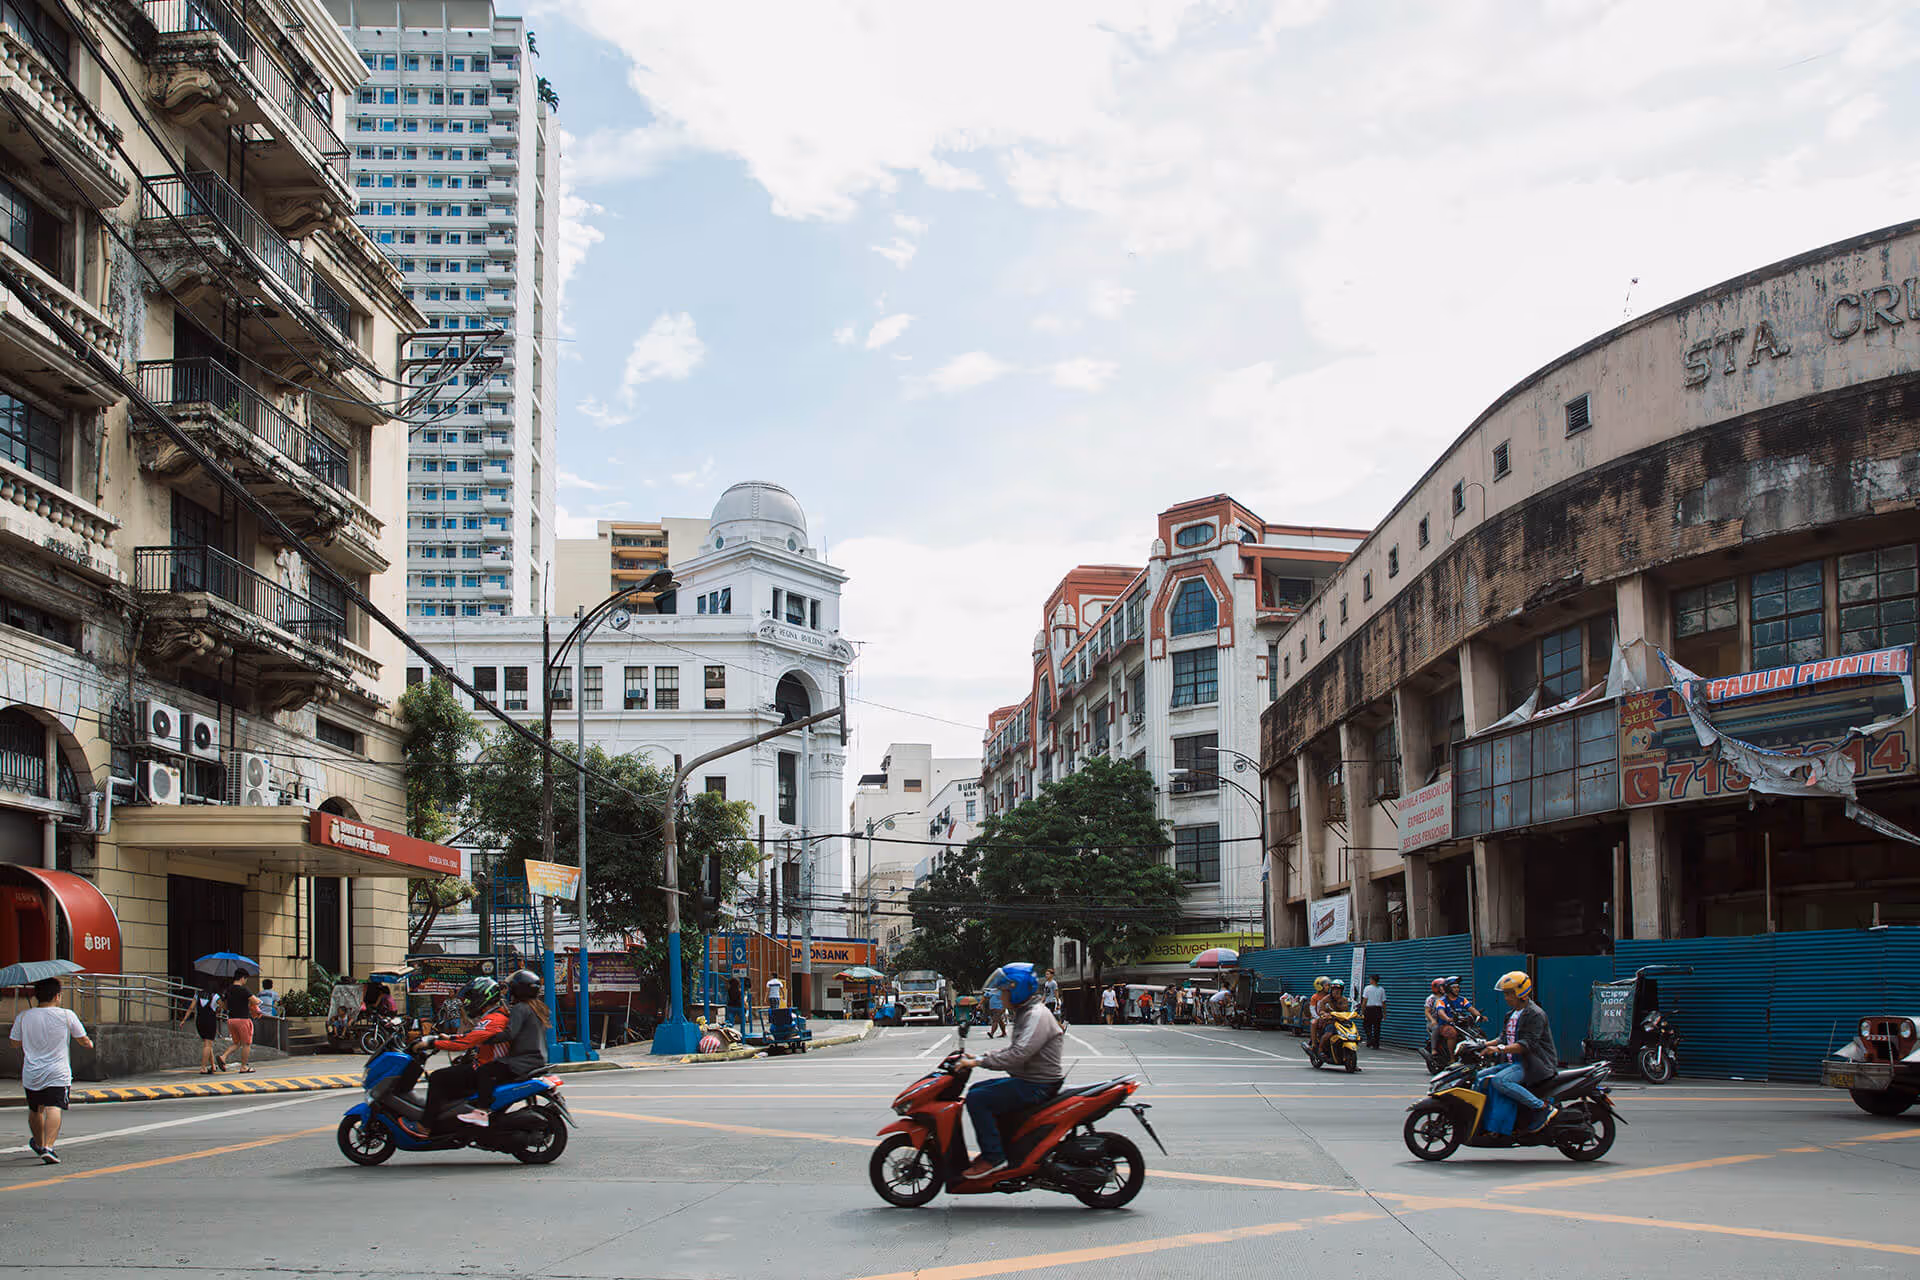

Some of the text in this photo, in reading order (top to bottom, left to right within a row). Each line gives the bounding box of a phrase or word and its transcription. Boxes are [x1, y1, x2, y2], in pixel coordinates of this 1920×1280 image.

[1797, 649, 1908, 683] PRINTER
[1627, 697, 1652, 712] WE
[1623, 709, 1658, 727] SELL
[1419, 784, 1441, 803] PENSION
[1407, 804, 1445, 829] EXPRESS LOANS
[1421, 823, 1450, 842] PENSIONER
[94, 935, 111, 951] BPI
[1154, 941, 1211, 956] eastwest
[791, 947, 849, 961] UNONBANK
[1604, 1009, 1622, 1017] KEN
